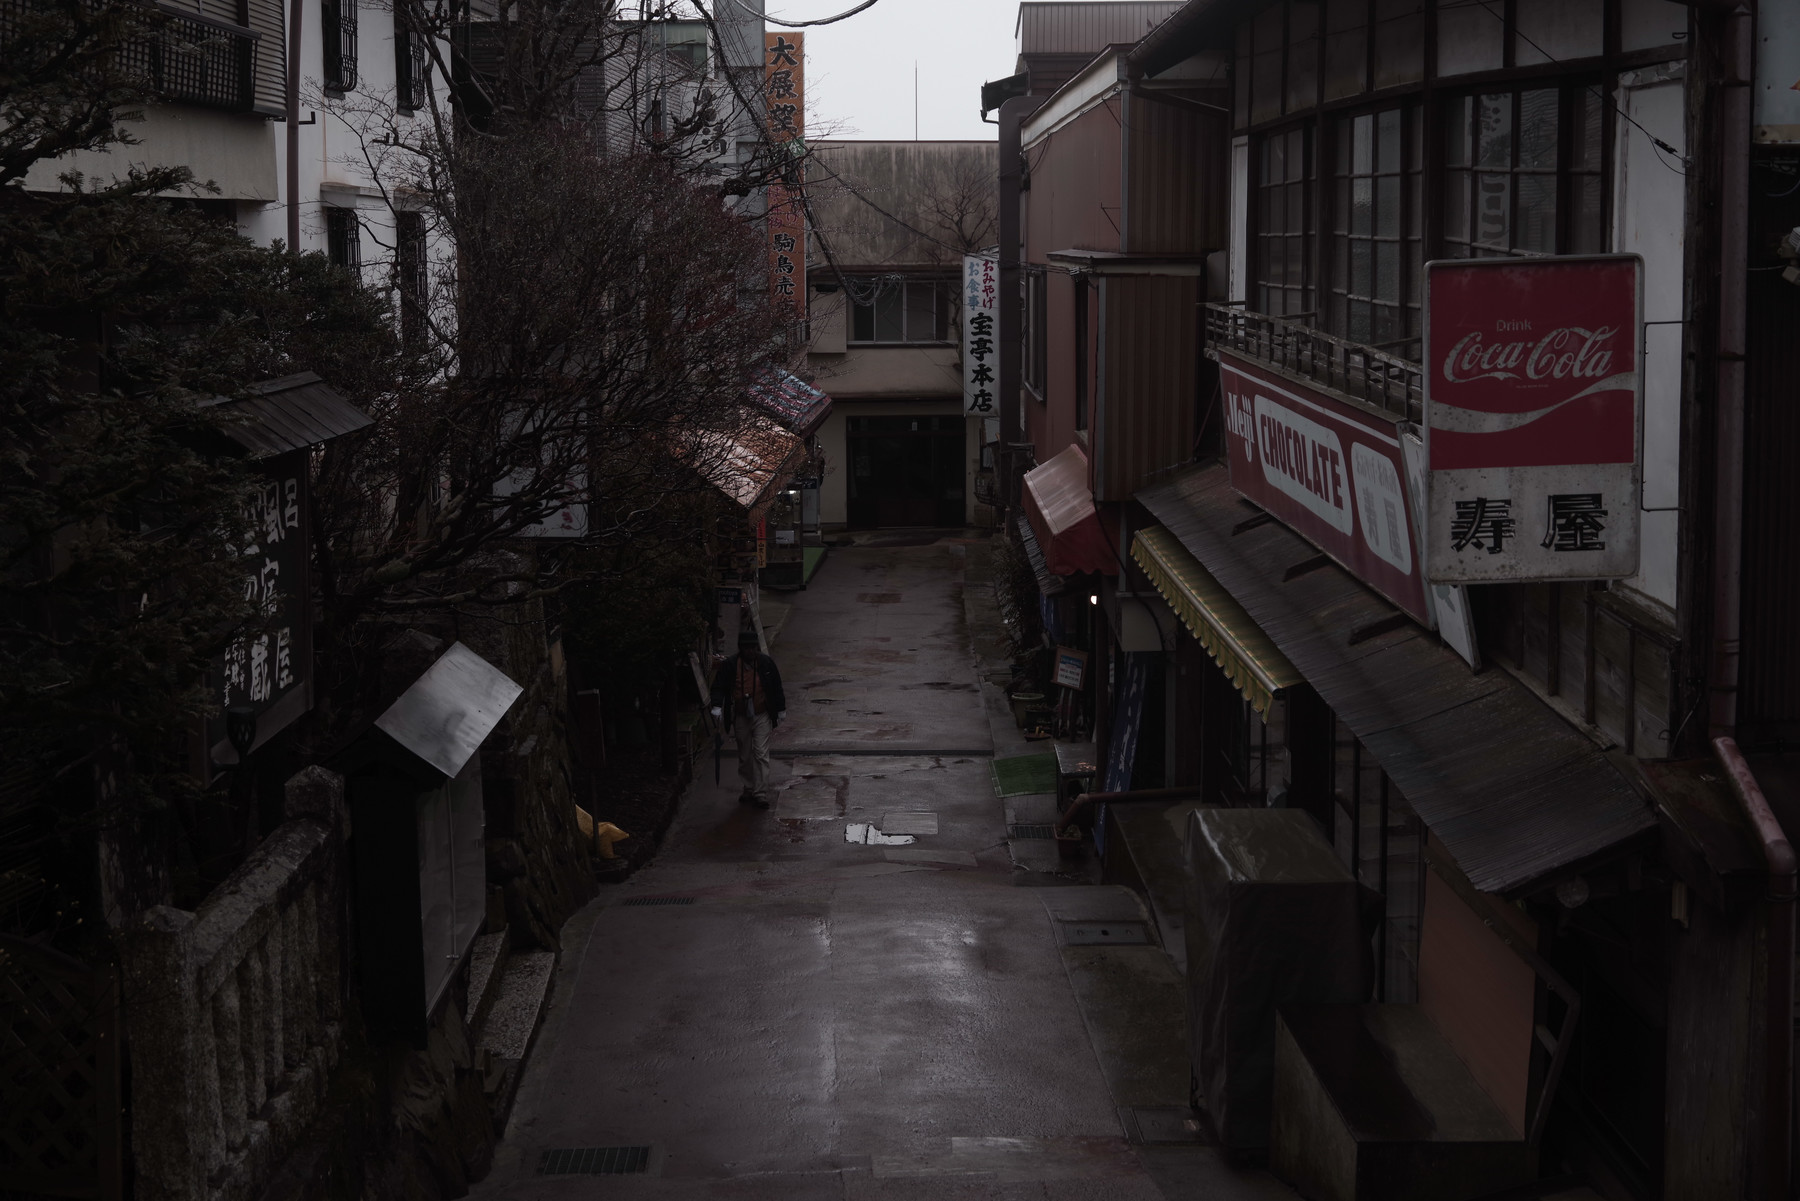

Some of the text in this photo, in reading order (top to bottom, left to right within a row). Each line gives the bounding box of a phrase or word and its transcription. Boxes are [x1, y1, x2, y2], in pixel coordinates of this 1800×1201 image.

[966, 261, 981, 311] お食事
[982, 260, 996, 310] おみやげ
[1496, 319, 1533, 333] Drink
[968, 312, 995, 412] 宝亭本店
[1227, 391, 1255, 463] Meiji
[1260, 413, 1344, 511] CHOCOLATE
[1451, 493, 1609, 555] 寿屋
